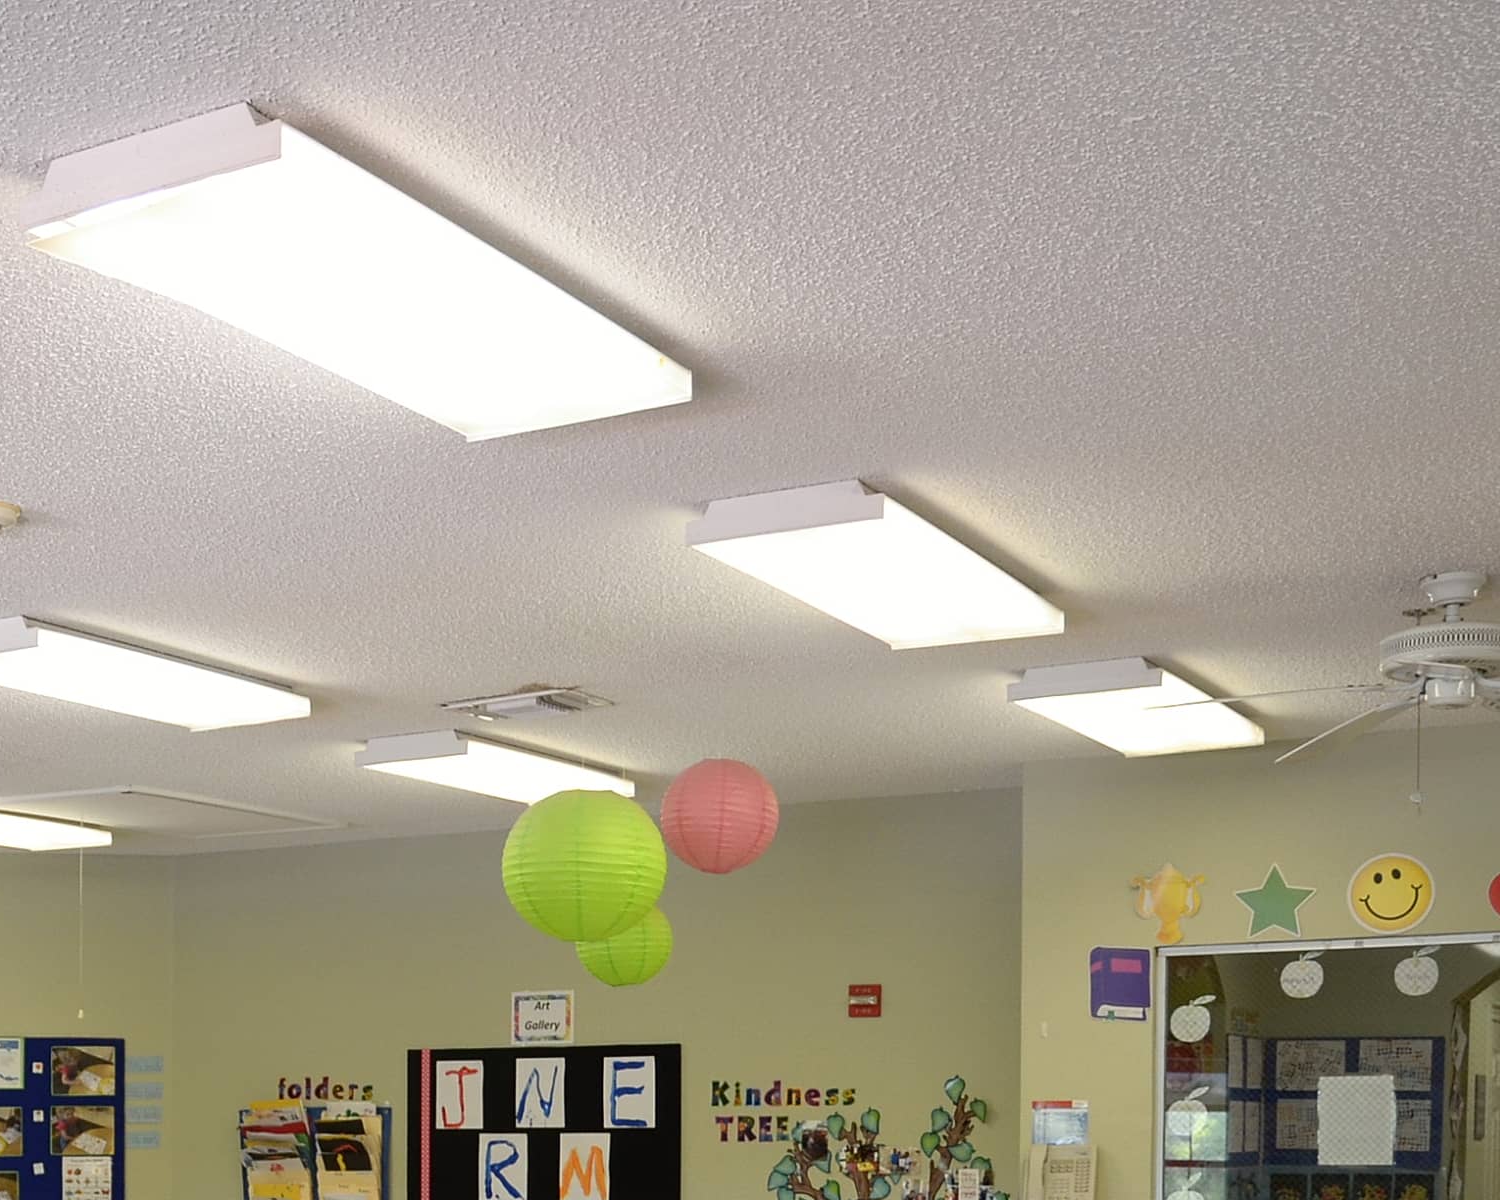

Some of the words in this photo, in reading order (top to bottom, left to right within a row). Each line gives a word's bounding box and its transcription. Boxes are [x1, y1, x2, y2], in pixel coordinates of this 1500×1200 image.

[524, 1020, 560, 1031] Gallery
[534, 1001, 550, 1010] Art
[278, 1076, 373, 1100] folders
[442, 1066, 478, 1128] J
[516, 1065, 558, 1124] N
[610, 1061, 647, 1127] E
[711, 1080, 856, 1106] Kindness
[715, 1116, 790, 1142] TREE
[485, 1140, 524, 1199] R
[560, 1145, 607, 1200] M
